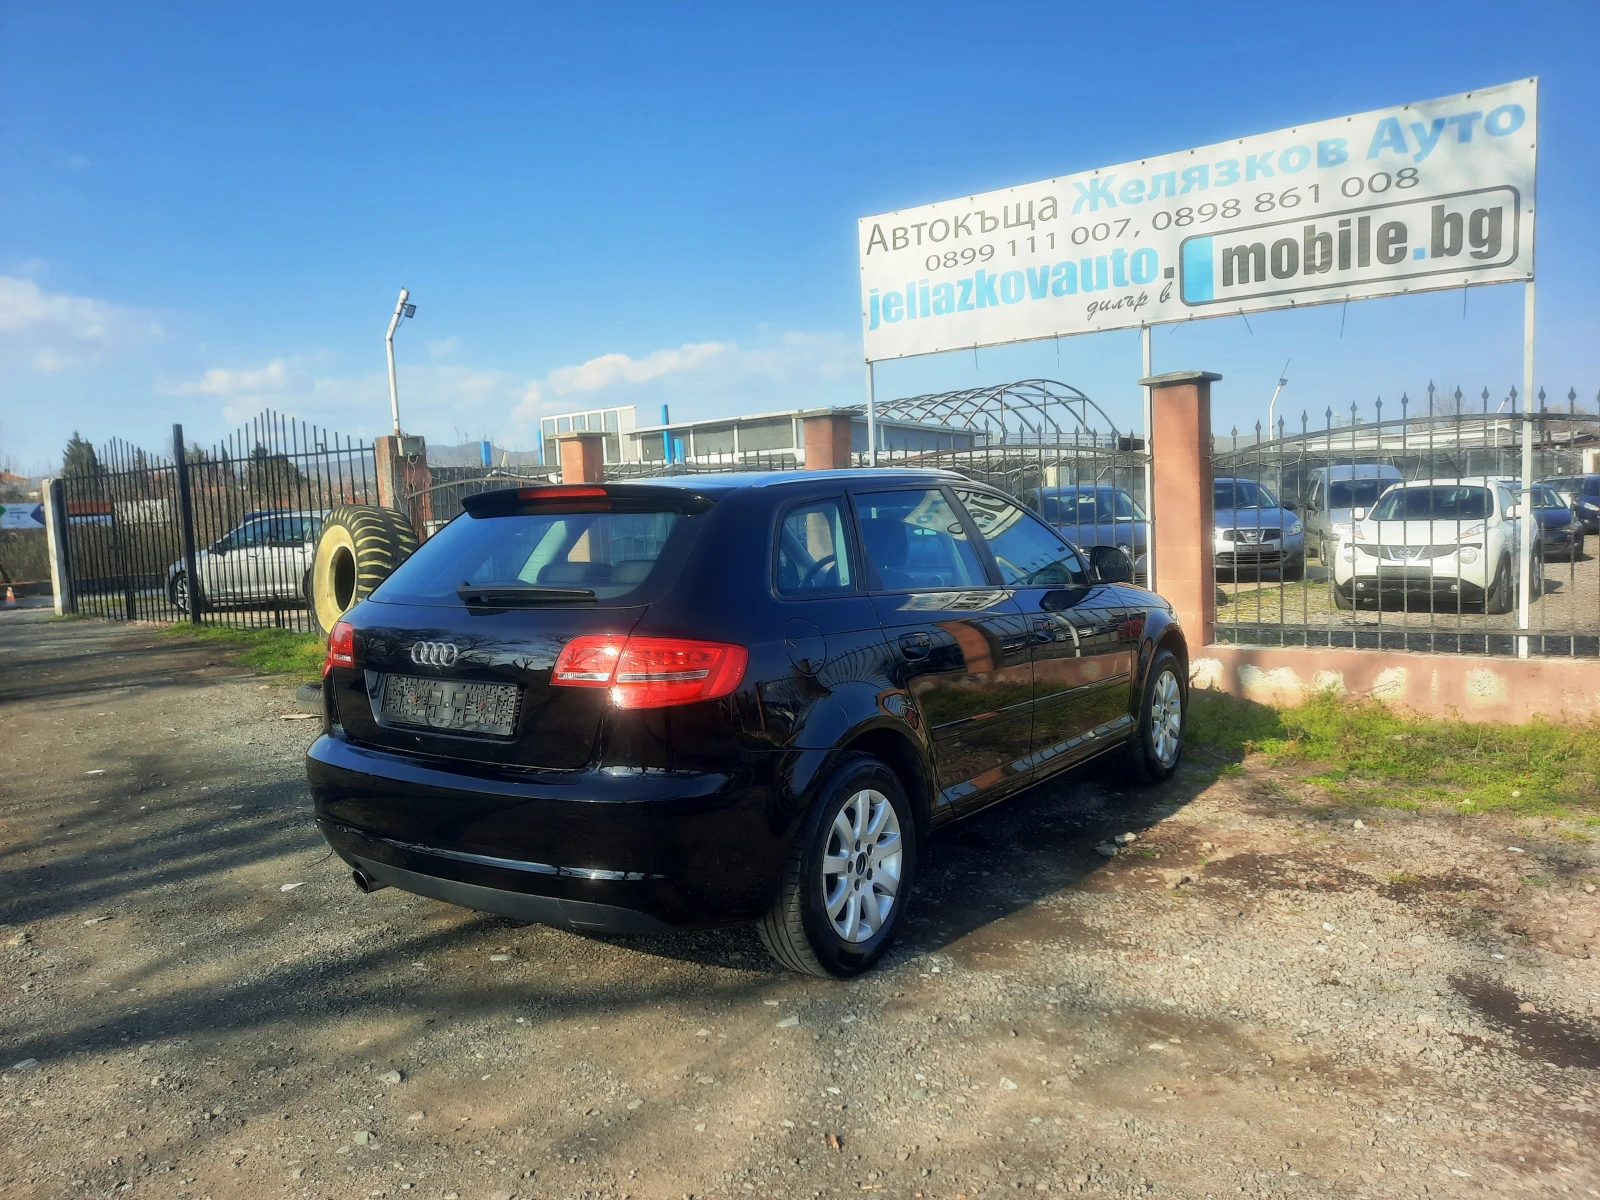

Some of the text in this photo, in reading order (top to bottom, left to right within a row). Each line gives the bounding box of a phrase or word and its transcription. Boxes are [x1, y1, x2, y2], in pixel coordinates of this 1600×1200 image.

[866, 103, 1526, 255] Автокъща Желязков Ауто
[925, 244, 995, 272] 0899
[1007, 231, 1057, 253] 111
[1152, 198, 1241, 231] 0898
[1254, 183, 1321, 213] 861
[1341, 167, 1420, 198] 008
[1222, 204, 1503, 287] mobile.bg
[1086, 281, 1173, 321] дилър в
